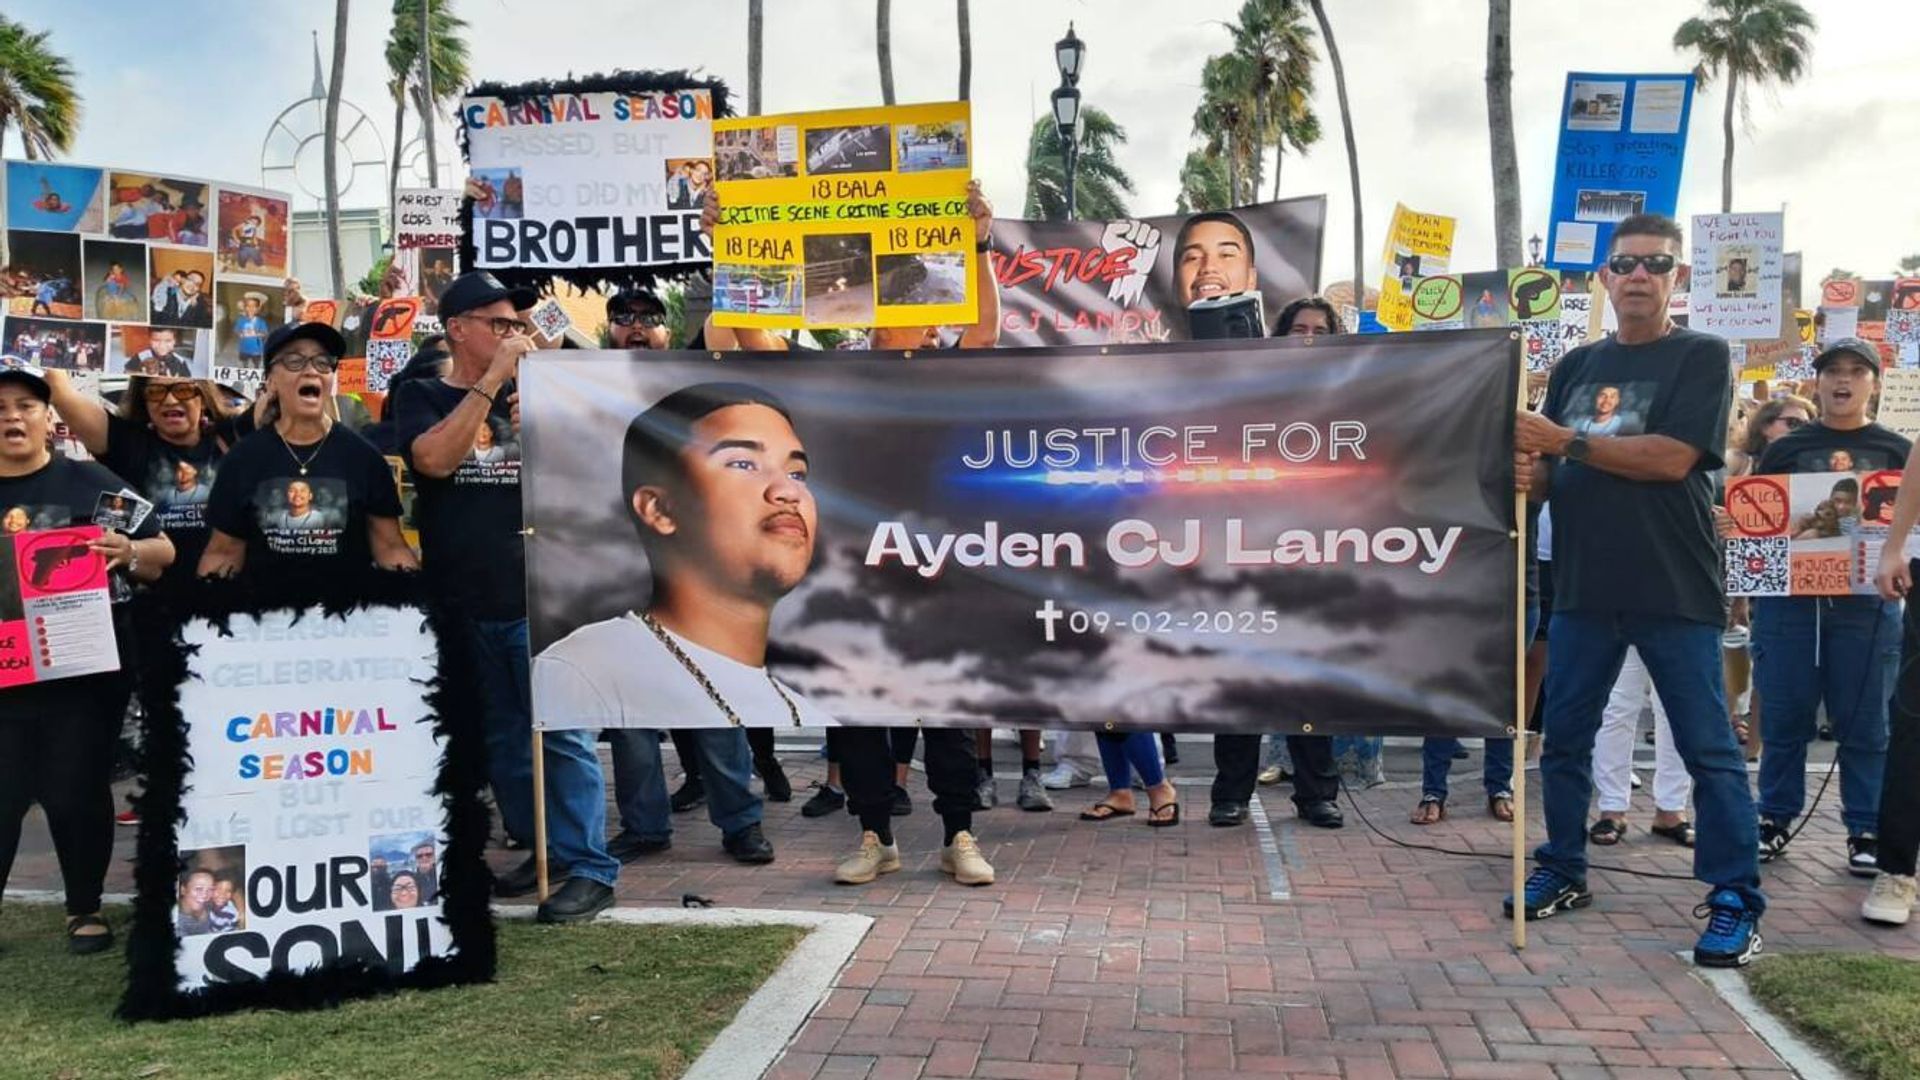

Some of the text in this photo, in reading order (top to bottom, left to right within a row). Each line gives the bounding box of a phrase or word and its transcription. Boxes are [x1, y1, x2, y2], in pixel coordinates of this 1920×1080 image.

[467, 94, 712, 130] CARNIVAL SEASON
[614, 132, 669, 155] BUT
[399, 194, 443, 206] ARREST
[576, 182, 621, 206] DID
[627, 182, 662, 206] MY
[812, 178, 887, 199] 18 BALA
[401, 212, 431, 226] COPS
[717, 204, 781, 225] CRIME
[788, 203, 831, 222] SCENE
[836, 202, 890, 219] CRIME
[896, 200, 941, 219] SCENE
[485, 214, 715, 263] BROTHER
[726, 236, 795, 261] 18 BALA
[889, 225, 962, 251] 18 BALA
[988, 246, 1138, 294] USTICE
[1002, 311, 1041, 332] CJ
[962, 421, 1368, 469] JUSTICE FOR
[864, 518, 1463, 578] Ayden CJ Lanoy
[1068, 609, 1279, 635] 09-02-2025
[212, 657, 413, 688] CELEBRATED
[226, 707, 397, 743] CARNIVAL
[239, 749, 373, 780] SEASON
[369, 806, 426, 830] OUR
[247, 855, 369, 918] OUR
